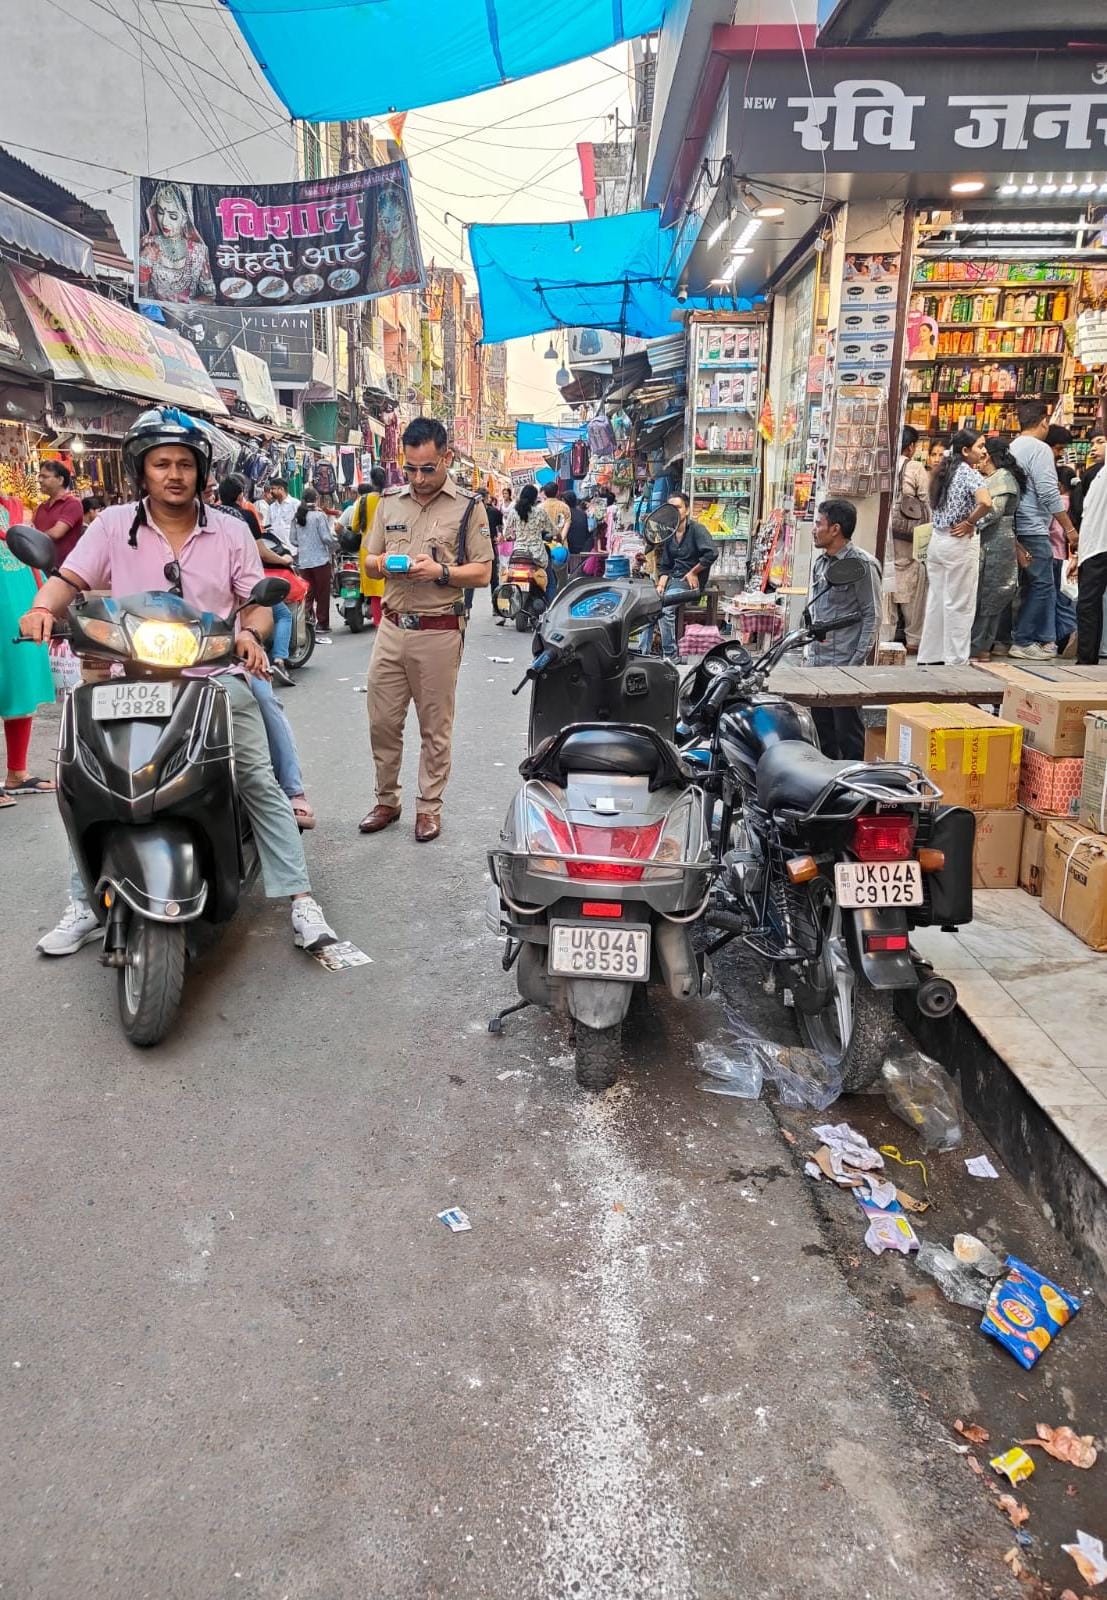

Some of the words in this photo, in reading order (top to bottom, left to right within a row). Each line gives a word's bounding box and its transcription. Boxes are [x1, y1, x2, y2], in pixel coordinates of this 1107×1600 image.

[743, 96, 777, 110] NEW
[787, 79, 926, 151] रवि
[215, 192, 365, 241] विशाल
[302, 231, 367, 269] आर्ट
[243, 317, 309, 329] VILLAIN
[116, 686, 160, 701] UK04
[111, 700, 166, 716] Y3828
[855, 864, 916, 884] UK04A
[855, 884, 914, 904] C9125
[571, 930, 637, 953] UK04A
[571, 951, 638, 974] C8539
